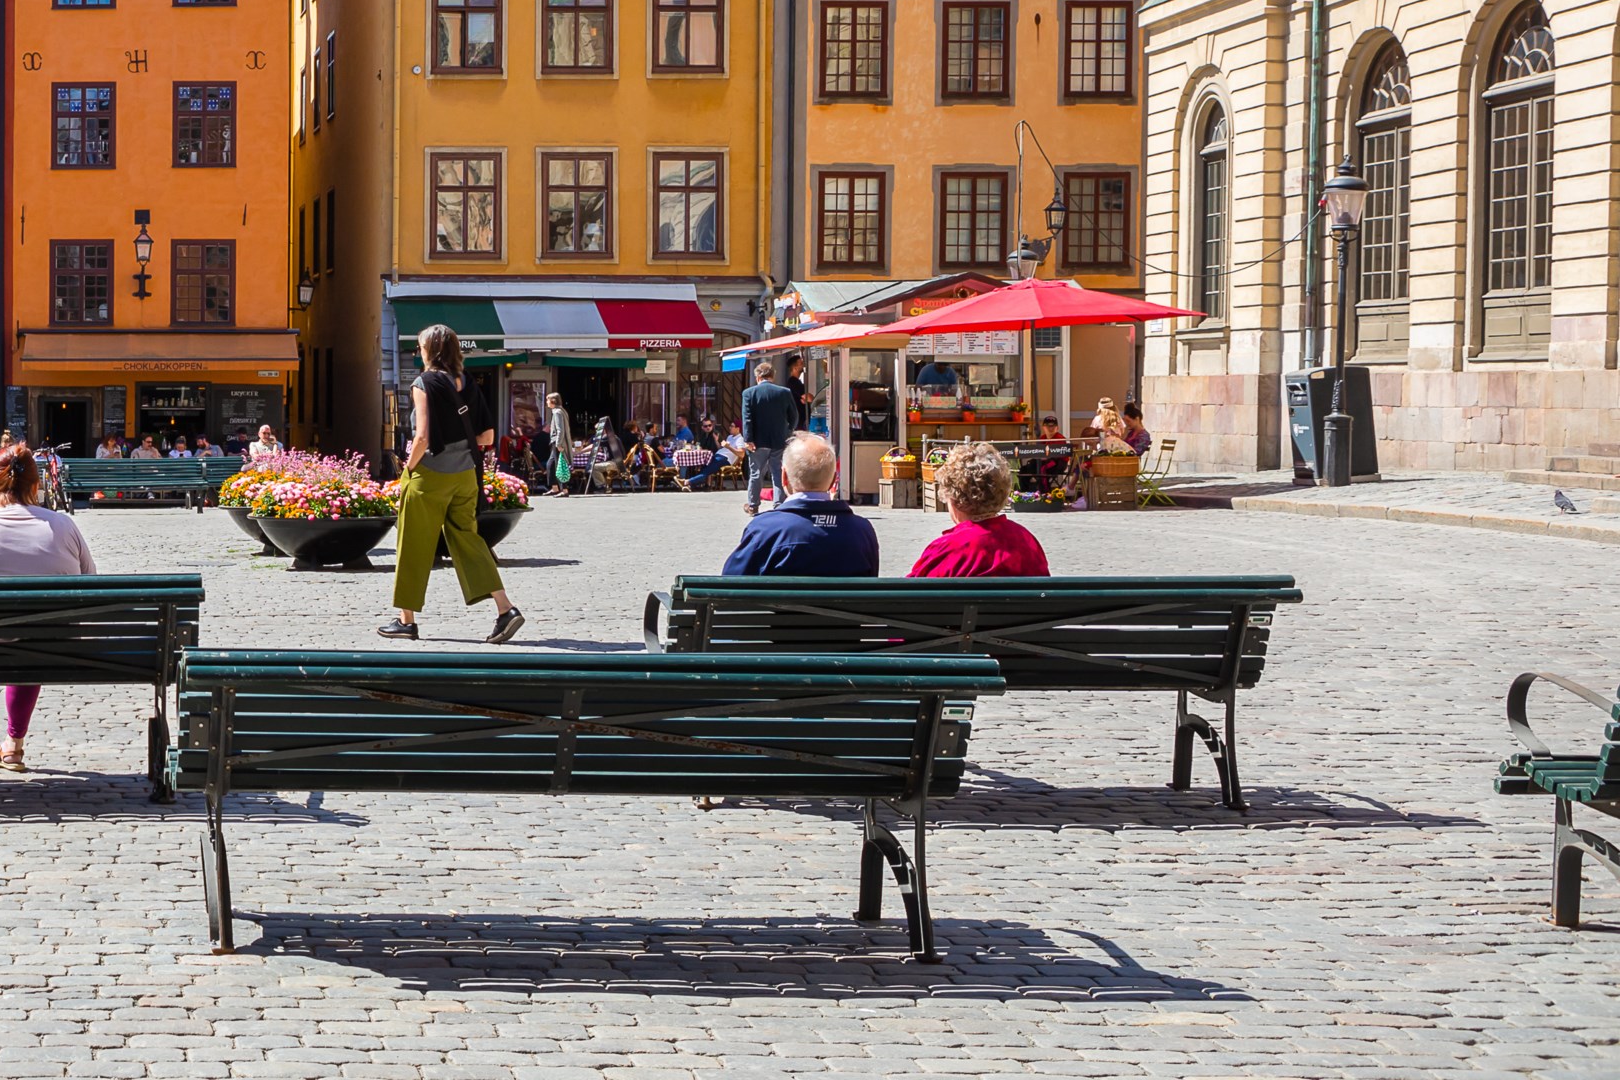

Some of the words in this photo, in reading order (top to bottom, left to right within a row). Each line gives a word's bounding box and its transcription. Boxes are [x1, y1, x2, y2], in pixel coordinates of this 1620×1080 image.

[459, 340, 477, 348] RIA
[640, 339, 681, 348] PIZZERIA
[123, 362, 203, 370] CHOKLADKOPPEN
